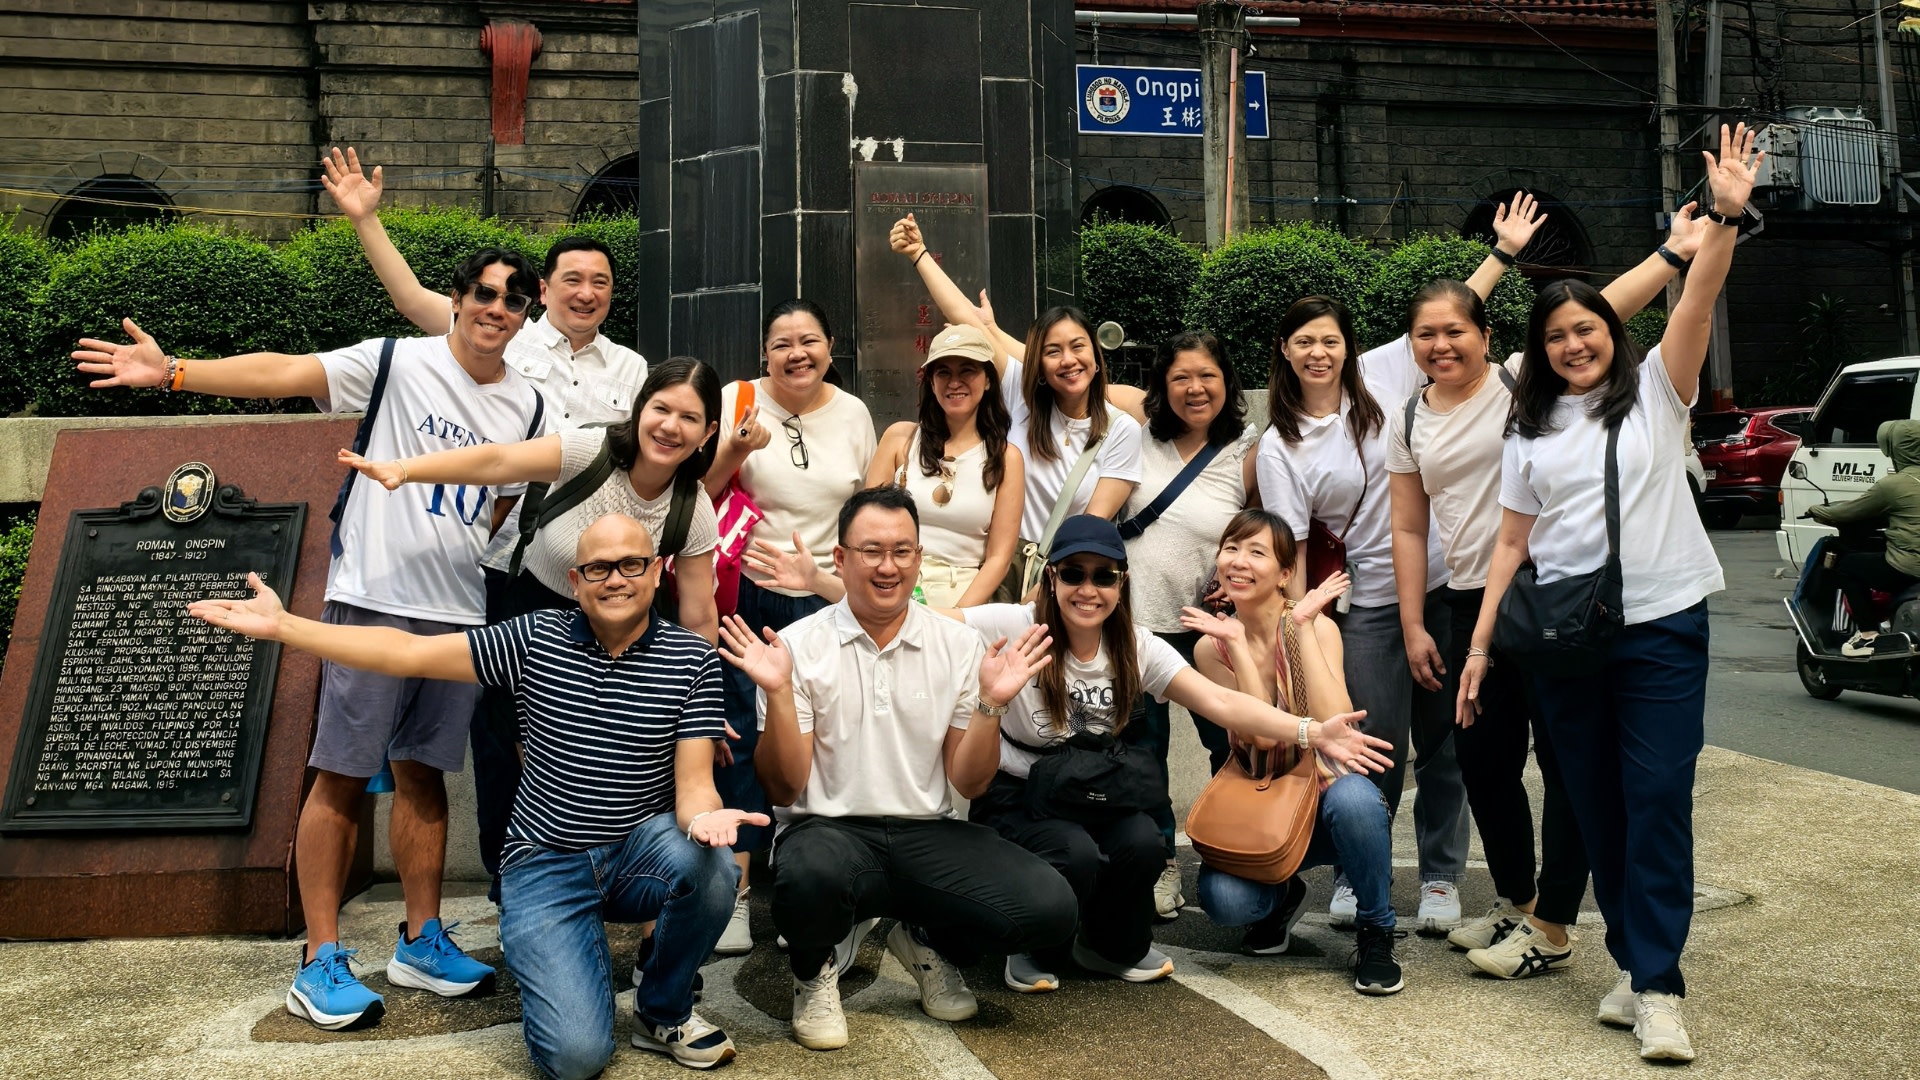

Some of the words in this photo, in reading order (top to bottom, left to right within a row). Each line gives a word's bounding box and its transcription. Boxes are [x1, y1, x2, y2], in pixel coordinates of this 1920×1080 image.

[1136, 76, 1200, 103] Ongpi
[1832, 462, 1876, 476] MLJ
[136, 540, 175, 550] ROMAN
[186, 539, 225, 549] ONGPIN
[97, 575, 146, 584] MAKABAYAN
[80, 585, 91, 593] SA
[183, 582, 195, 590] 28
[200, 581, 239, 590] PEBRERO
[77, 594, 116, 602] NAHALAL
[123, 592, 154, 600] BILANG
[163, 591, 202, 599] TENIENTE
[209, 590, 246, 598] PRIMERO
[75, 602, 116, 611] MESTIZOS
[73, 611, 110, 620] ITINATAG
[71, 620, 110, 629] GUMAMIT
[134, 619, 175, 627] PARAANG
[69, 630, 98, 638] KALYE
[102, 629, 130, 637] COLON
[178, 627, 210, 635] BAHAGI
[68, 639, 85, 647] SAN
[187, 636, 233, 644] TUMULONG
[65, 648, 106, 656] KILUSANG
[180, 645, 207, 653] IPINIIT
[215, 645, 228, 653] NG
[62, 657, 104, 666] ESPANYOL
[110, 656, 134, 664] DAHIL
[157, 655, 197, 663] KANYANG
[202, 654, 253, 662] PAGTULONG
[60, 667, 72, 675] SA
[74, 666, 93, 674] MGA
[205, 663, 251, 671] IKINULONG
[58, 676, 79, 685] MULI
[80, 676, 93, 684] NG
[95, 675, 113, 683] MGA
[178, 673, 226, 681] DISYEMBRE
[229, 672, 250, 680] 1900
[56, 685, 103, 694] HANGGANG
[130, 684, 160, 692] MARSO
[193, 682, 248, 690] NAGLINGKOD
[54, 695, 84, 703] BILANG
[176, 692, 203, 700] UNION
[210, 691, 245, 700] OBRERA
[145, 702, 179, 711] NAGING
[182, 701, 225, 710] PANGULO
[230, 701, 244, 709] NG
[50, 714, 68, 722] MGA
[74, 713, 122, 722] SAMAHANG
[126, 712, 156, 720] SIBIKO
[160, 712, 189, 720] TULAD
[194, 711, 208, 719] NG
[216, 711, 242, 719] CASA
[48, 724, 71, 732] ASILO
[80, 723, 93, 731] DE
[100, 722, 145, 730] INVALIDOS
[152, 721, 195, 729] FILIPINOS
[203, 721, 222, 729] POR
[88, 733, 100, 741] LA
[104, 731, 160, 741] PROTECCION
[164, 731, 176, 740] DE
[180, 731, 191, 739] LA
[197, 730, 238, 738] INFANCIA
[44, 743, 54, 751] AT
[58, 742, 80, 751] GOTA
[84, 742, 97, 750] DE
[172, 740, 181, 748] 10
[185, 740, 237, 749] DISYEMBRE
[75, 751, 135, 760] IPINANGALAN
[146, 751, 158, 759] SA
[170, 750, 201, 758] KANYA
[216, 750, 235, 758] ANG
[38, 763, 69, 771] DAANG
[75, 761, 121, 770] SACRISTIA
[127, 761, 140, 769] NG
[146, 760, 181, 769] LUPONG
[187, 760, 232, 768] MUNISIPAL
[37, 773, 50, 781] NG
[62, 772, 101, 780] MAYNILA
[113, 771, 146, 780] BILANG
[158, 770, 208, 778] PAGKILALA
[220, 769, 231, 777] SA
[34, 782, 77, 791] KANYANG
[85, 782, 104, 790] MGA
